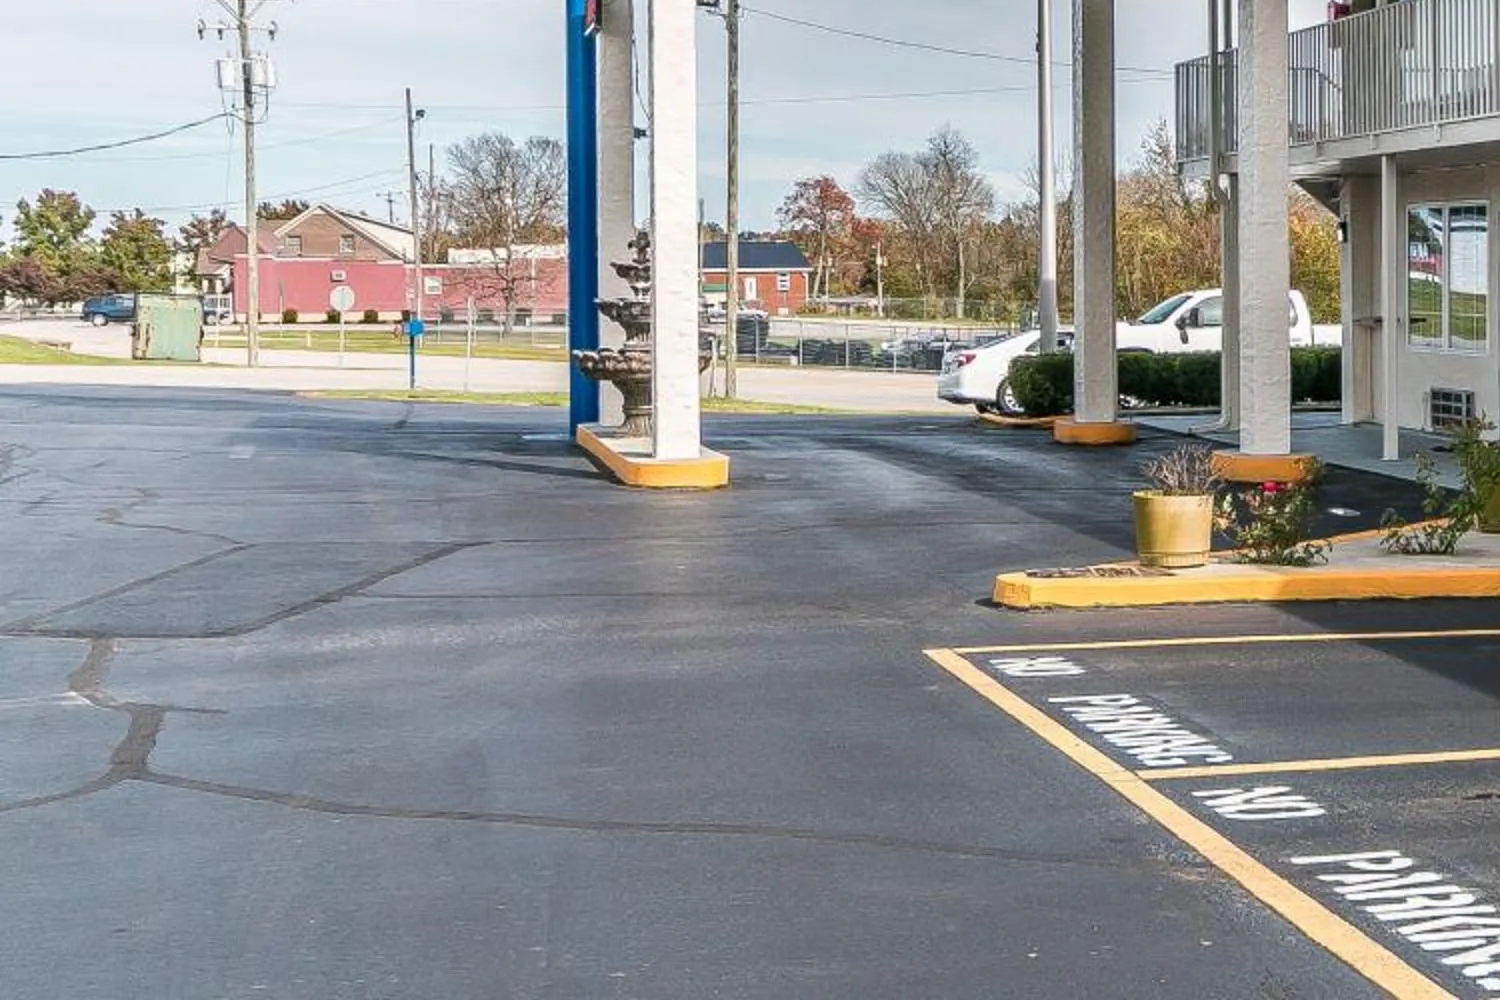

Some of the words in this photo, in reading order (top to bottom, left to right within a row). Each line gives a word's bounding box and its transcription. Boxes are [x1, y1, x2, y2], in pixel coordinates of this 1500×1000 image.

[988, 657, 1086, 676] NO
[1047, 694, 1233, 767] PARKING
[1192, 786, 1326, 820] NO
